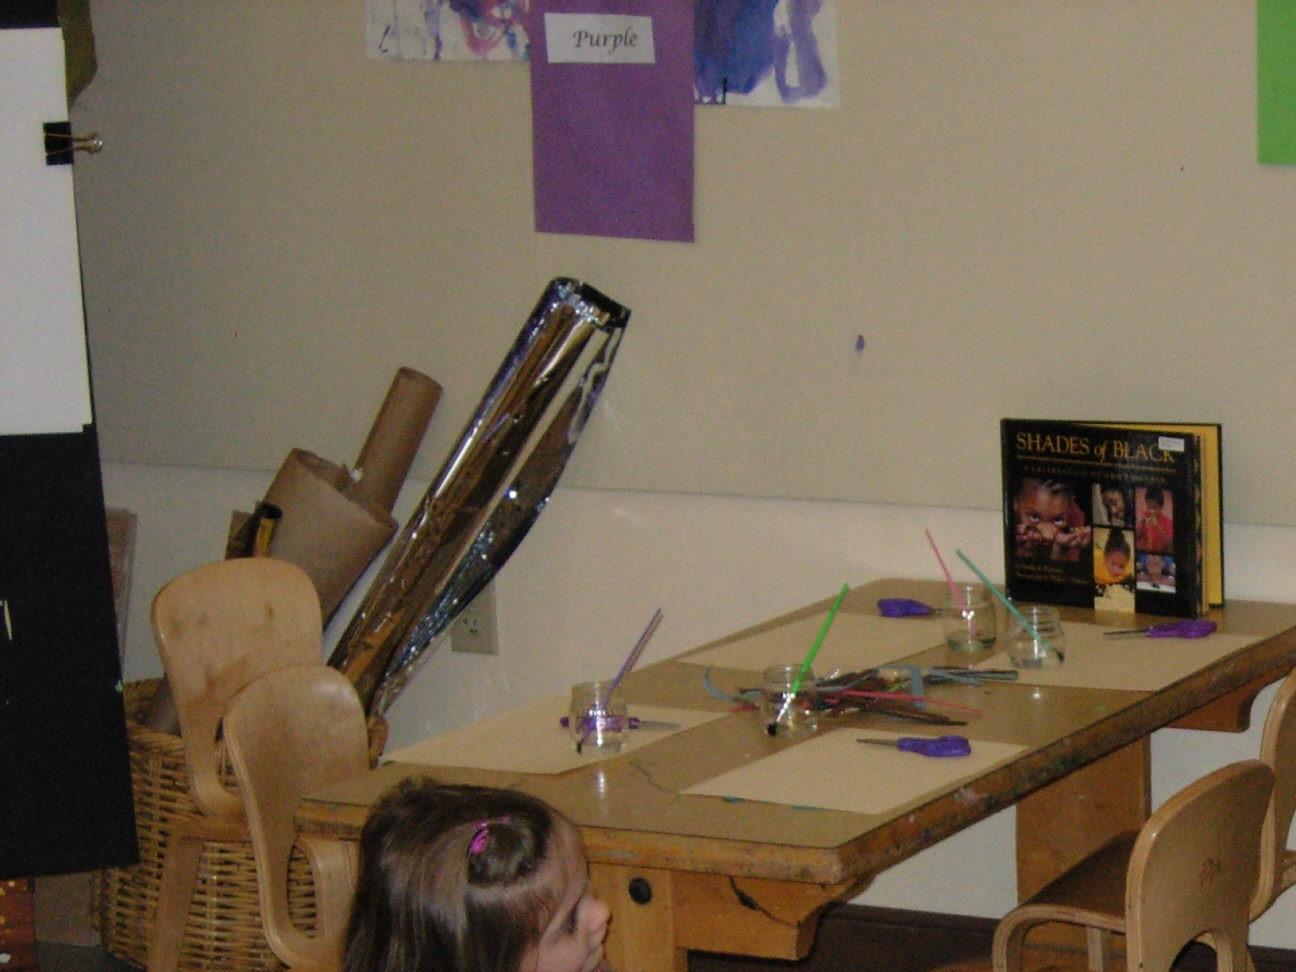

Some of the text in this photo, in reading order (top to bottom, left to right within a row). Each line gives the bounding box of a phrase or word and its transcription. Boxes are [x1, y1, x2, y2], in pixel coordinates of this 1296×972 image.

[573, 26, 637, 54] Purple
[1016, 431, 1089, 454] SHADES
[1094, 440, 1108, 464] of
